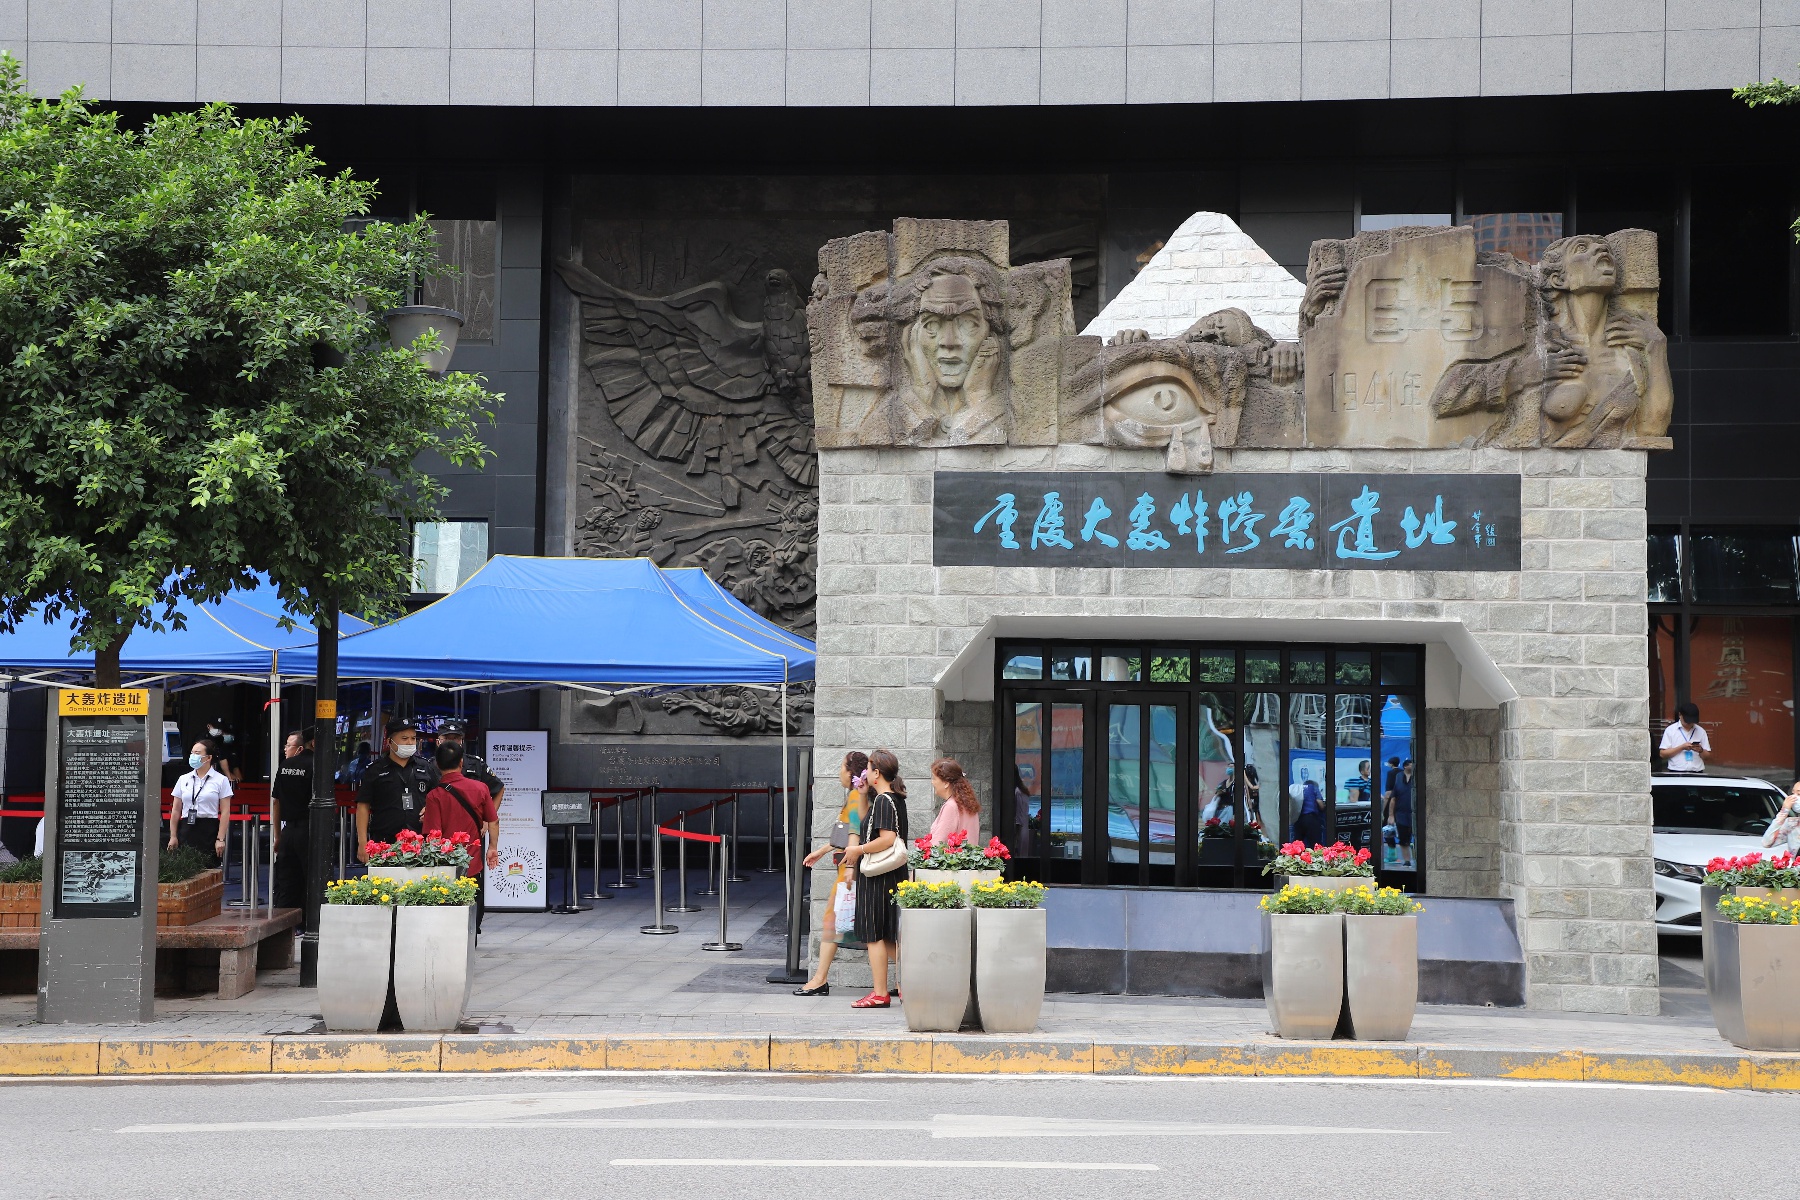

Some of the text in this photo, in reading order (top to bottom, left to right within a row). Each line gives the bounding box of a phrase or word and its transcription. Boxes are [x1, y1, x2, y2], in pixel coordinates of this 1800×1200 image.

[1328, 371, 1422, 412] 1941年
[66, 692, 141, 706] 大轰炸遗址
